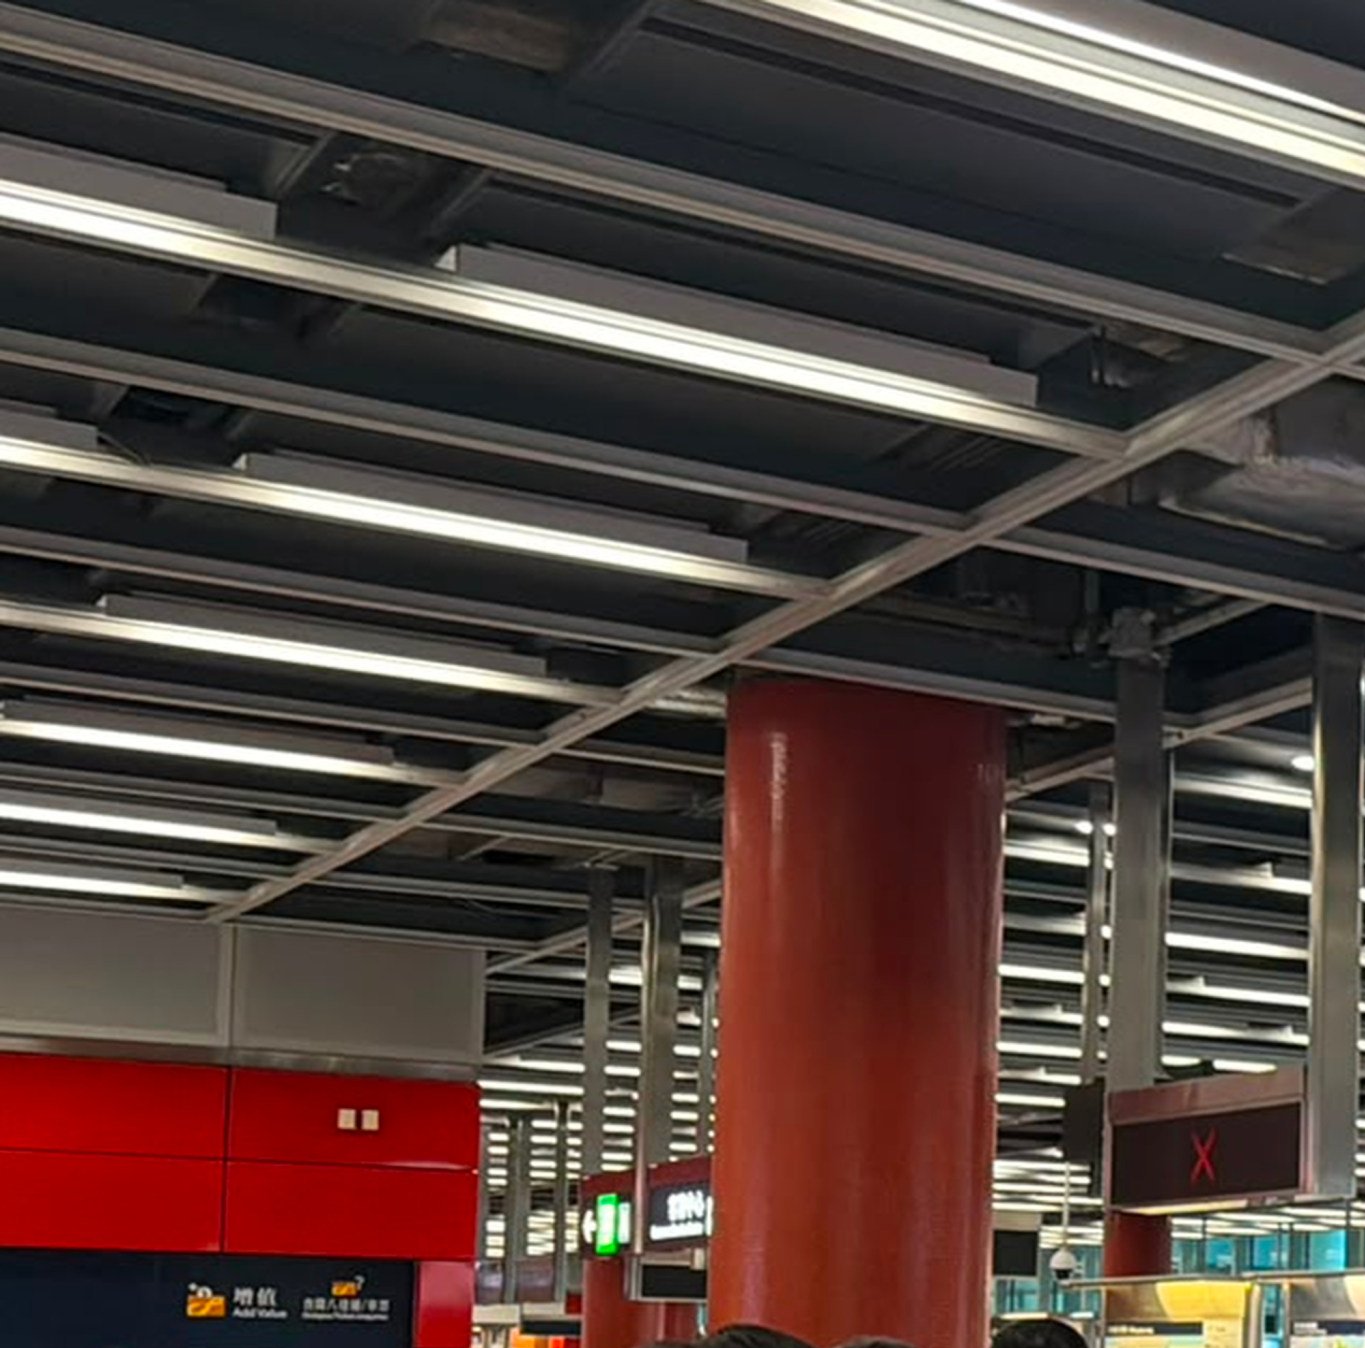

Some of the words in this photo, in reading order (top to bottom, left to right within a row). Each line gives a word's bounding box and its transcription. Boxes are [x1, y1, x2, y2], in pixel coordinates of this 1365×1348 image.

[233, 1286, 278, 1306] 增值
[233, 1309, 255, 1318] Add
[257, 1309, 288, 1319] Value
